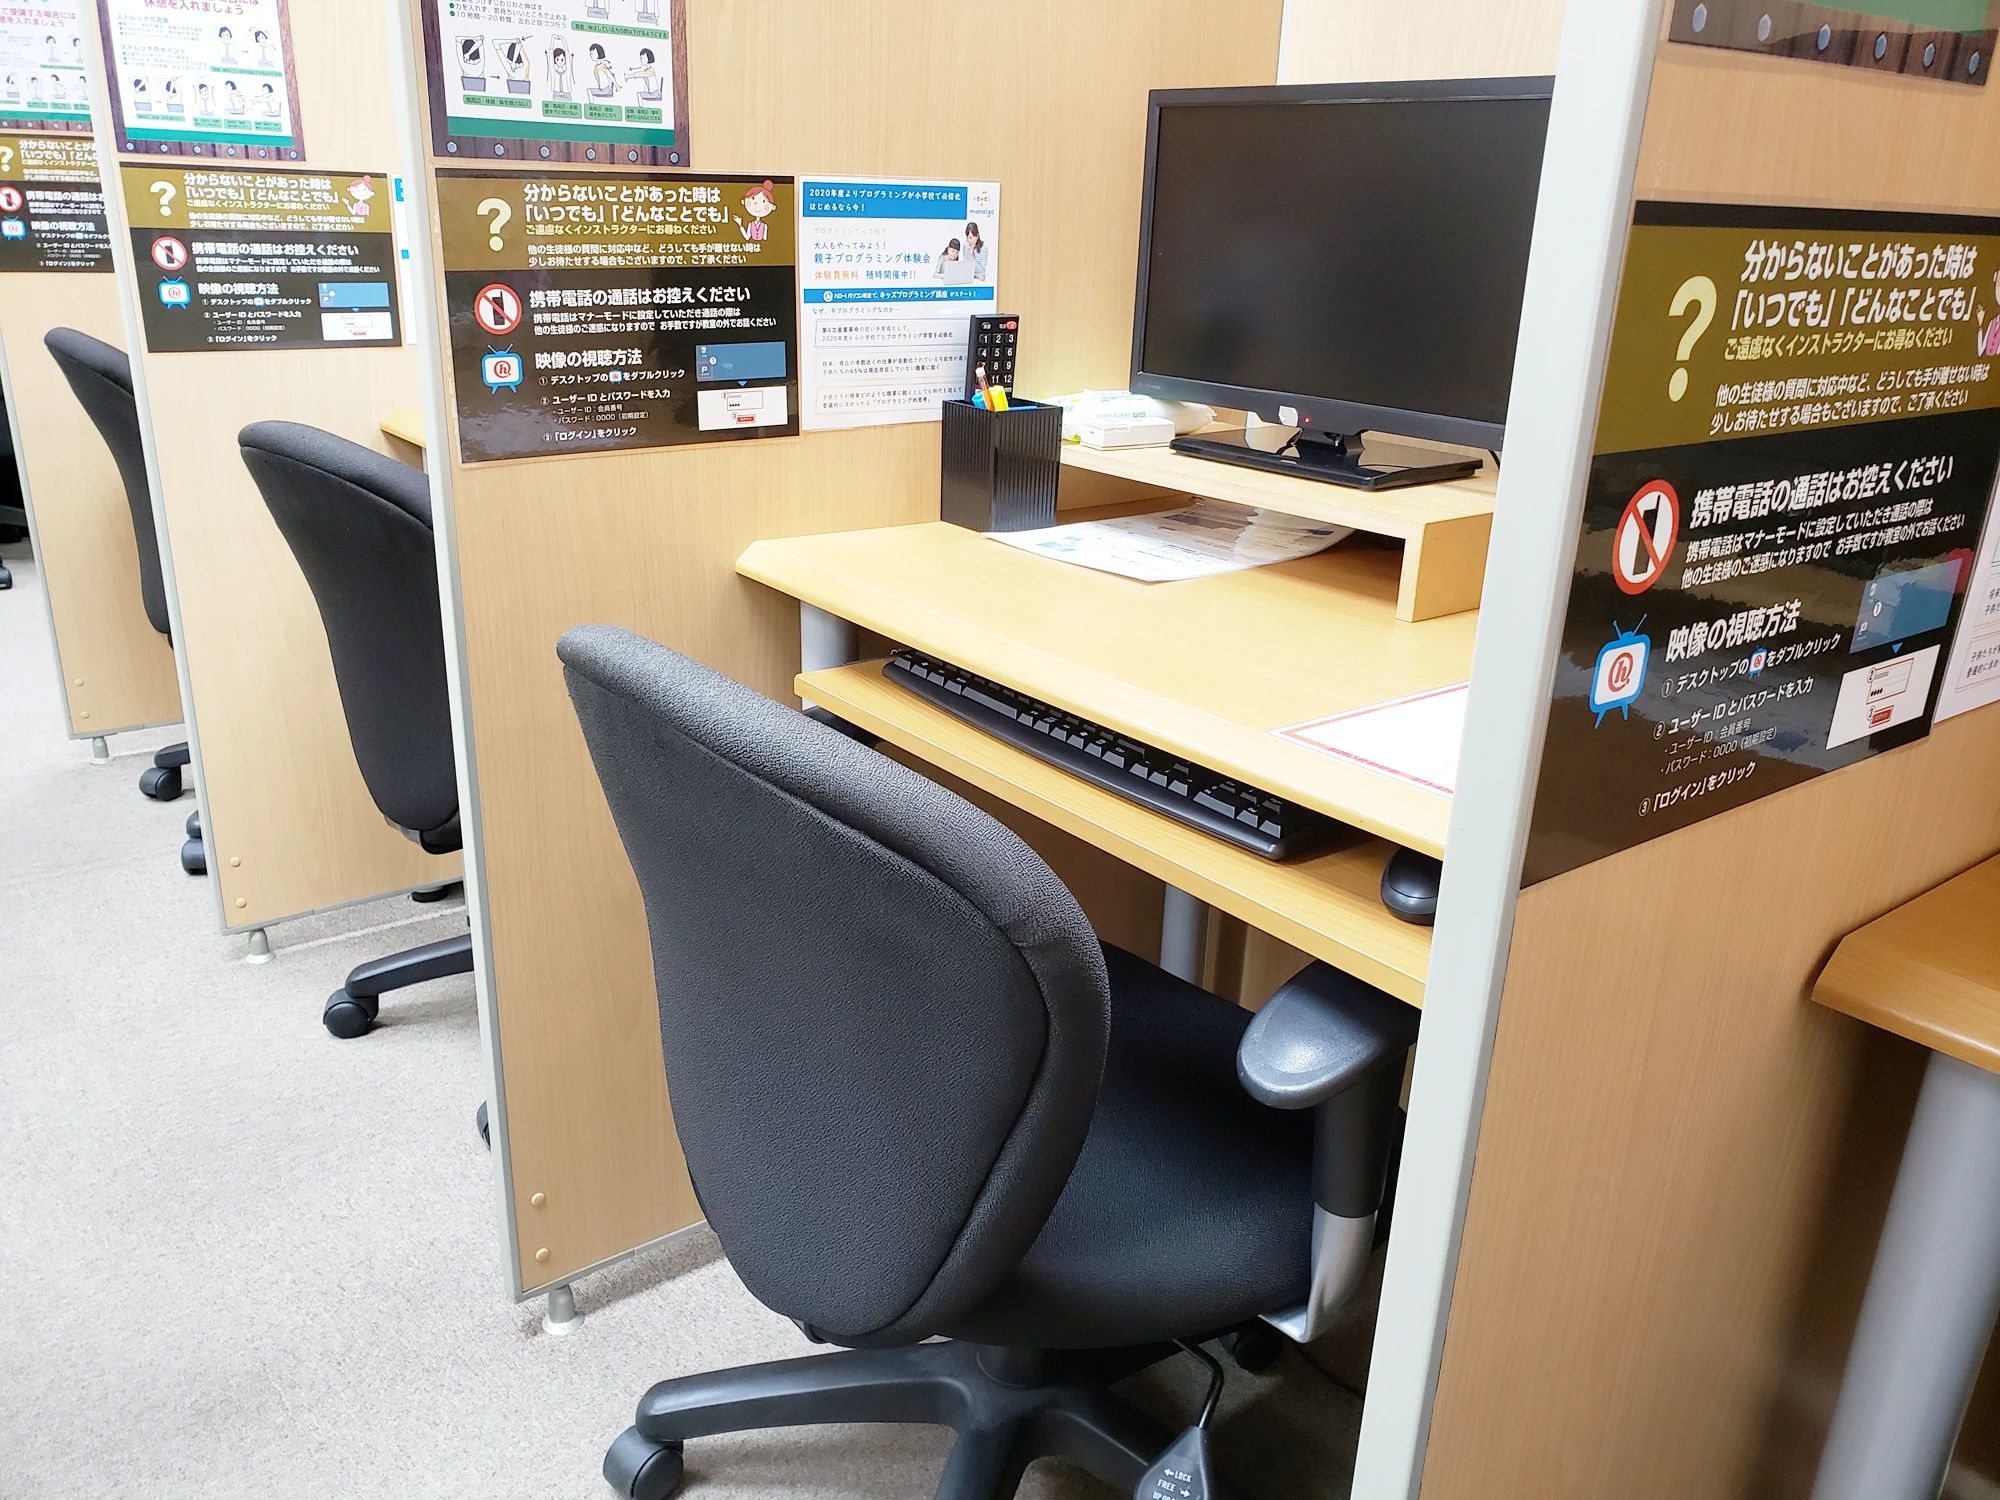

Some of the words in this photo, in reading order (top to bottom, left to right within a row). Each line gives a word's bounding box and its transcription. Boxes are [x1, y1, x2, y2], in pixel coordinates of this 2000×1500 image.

[183, 172, 332, 190] 分からないことがあった時は
[185, 185, 339, 203] 「いつでも」「どんなことでも」
[523, 183, 721, 204] 分からないことがあった時は
[809, 188, 962, 201] 2020年度よりプログラミングが小学校で必修化
[525, 204, 729, 224] 「いつでも」「どんなことでも」
[525, 224, 717, 236] ご遠慮なくインストラクターにお尋ねください
[191, 242, 360, 256] 携帯電話の通話はお控えください
[527, 243, 762, 255] 他の生徒様の質問に対応中など、どうしても手が離せない時は
[528, 255, 747, 268] 少しお待たせする場合もございますので、ご了承ください
[814, 252, 931, 264] 親子プログラミング体験会
[1740, 239, 1978, 283] 分からないことがあった時は
[197, 282, 280, 295] 映像の視聴方法
[529, 286, 751, 309] 携帯電話の通話はお控えください
[533, 307, 742, 323] 携帯電話はマナーモードに設定していただき通話の際は
[1731, 286, 1977, 331] 「いつでも」「どんなことでも」
[983, 335, 988, 344] 1
[995, 334, 1001, 344] 2
[1008, 334, 1014, 343] 3
[1723, 327, 1953, 361] ご遠慮なくインストラクターにお尋ねください
[981, 348, 987, 357] 4
[994, 348, 1000, 357] 5
[1007, 347, 1013, 356] 6
[535, 348, 643, 370] 映像の視聴方法
[993, 361, 999, 370] 8
[1006, 361, 1011, 370] 9
[622, 369, 686, 382] をダブルクリック
[991, 375, 999, 384] 11
[1004, 374, 1012, 383] 12
[1715, 363, 1991, 407] 他の生徒様の質問に対応中など、どうしても手が離せない時は
[1709, 389, 1969, 436] 少しお待たせする場合もございますので、ご了承ください
[554, 426, 637, 442] 「ログイン」をクリック
[1689, 455, 1954, 530] 携帯電話の通話はお控えください
[1685, 497, 1934, 564] 携帯電話はマナーモードに設定していただき通話の際は
[1681, 541, 1832, 590] 他の生徒様のご迷惑になりますので
[1664, 598, 1802, 664] 映像の視聴方法
[1676, 658, 1750, 694] デスクトップの
[1765, 633, 1842, 668] をダブルクリック
[1653, 761, 1756, 812] 「ログイン」をクリック
[1174, 1470, 1192, 1483] LOCK
[1157, 1479, 1176, 1492] FREE
